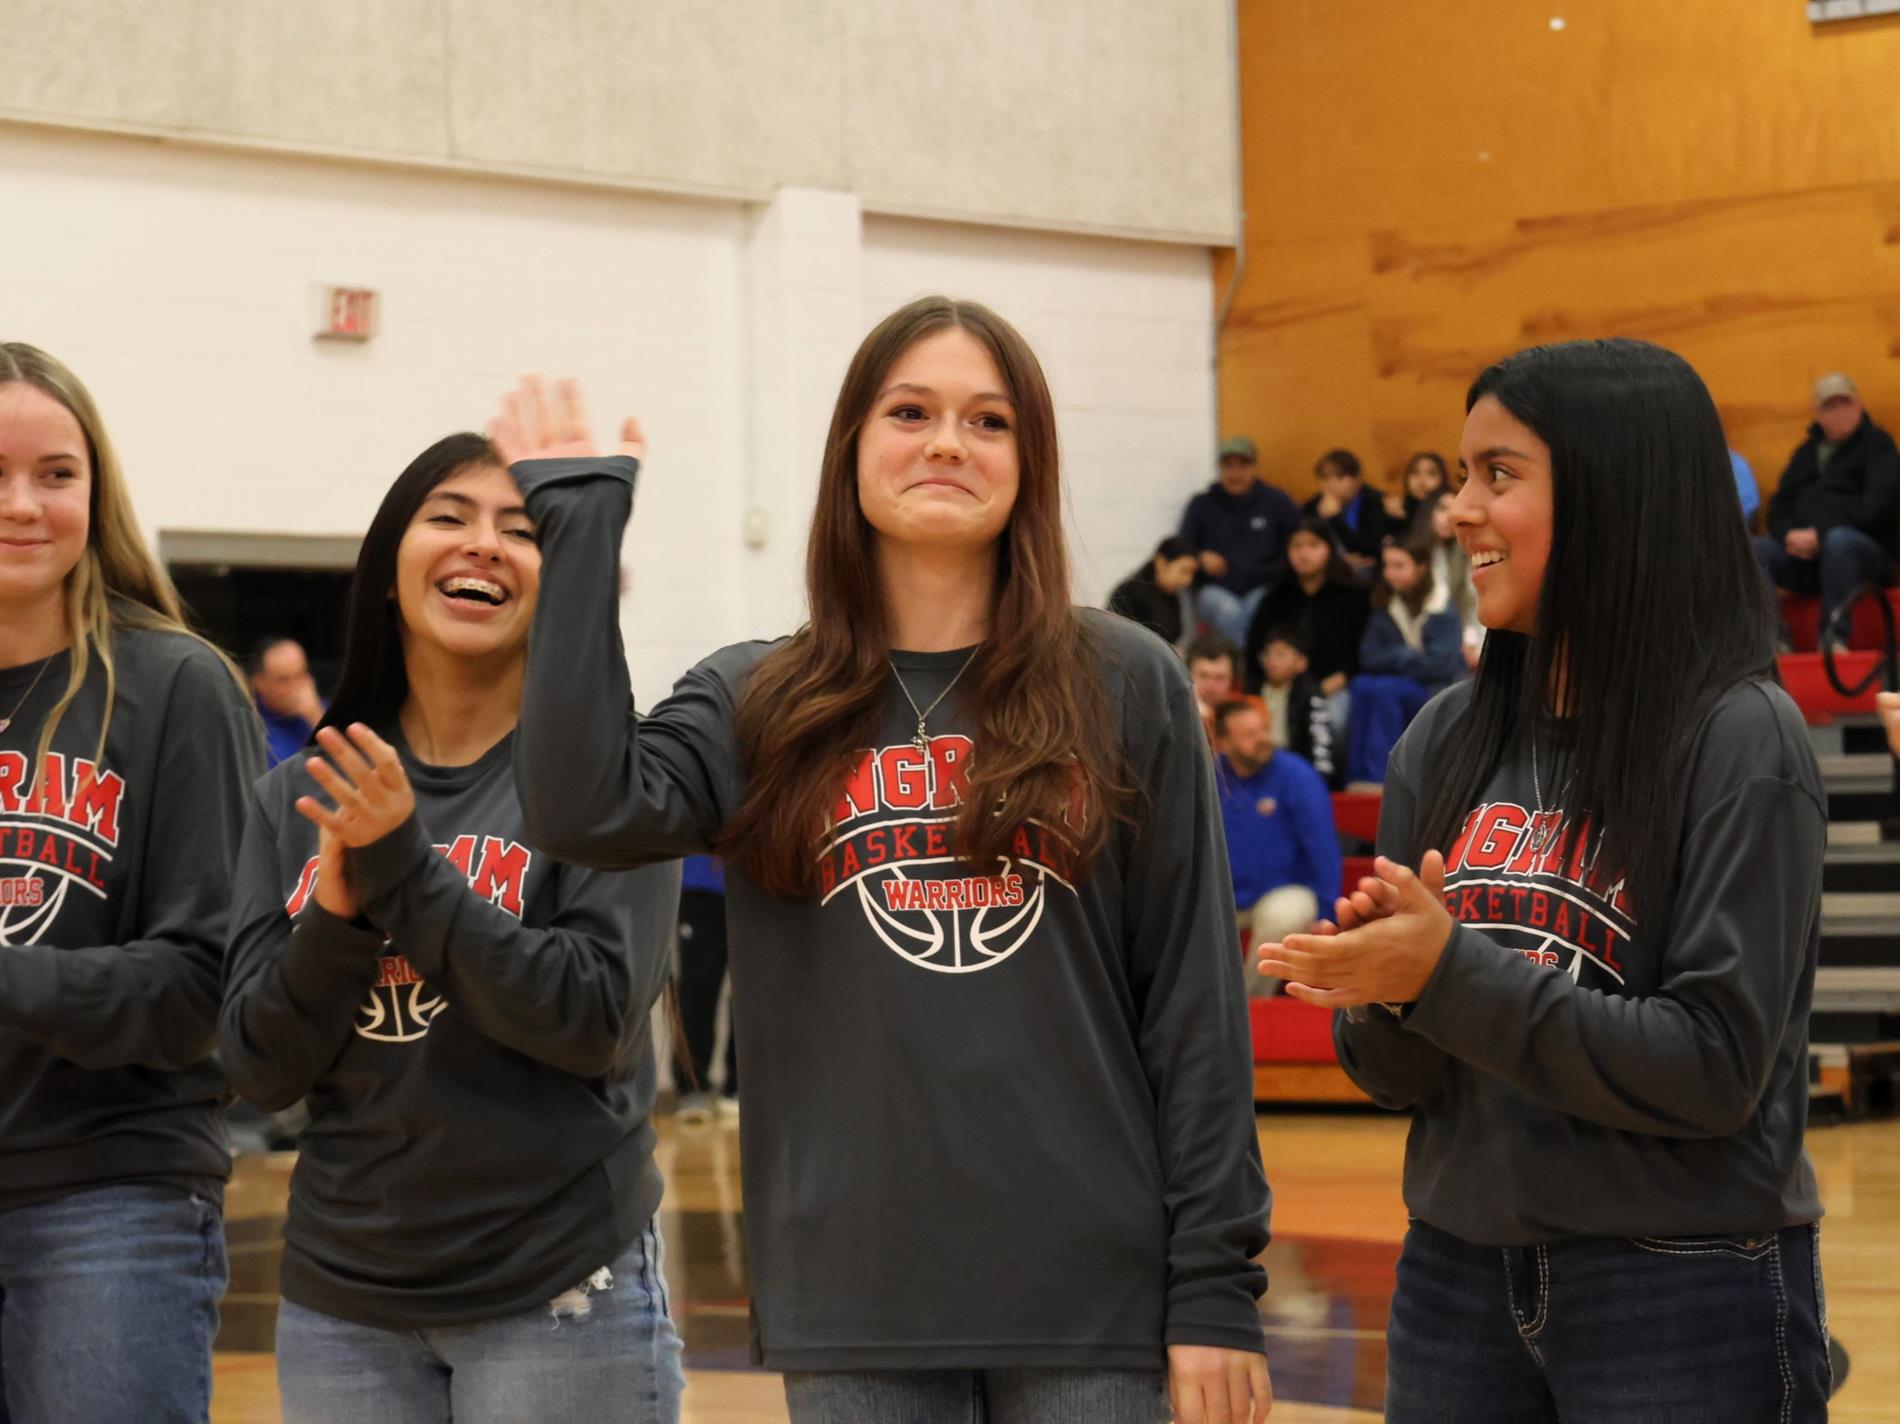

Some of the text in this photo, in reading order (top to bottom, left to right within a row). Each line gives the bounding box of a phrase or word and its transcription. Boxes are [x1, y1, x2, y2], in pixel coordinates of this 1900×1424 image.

[0, 750, 126, 849] RAM
[806, 734, 1087, 842] NGR
[818, 822, 1077, 896] BASKEAL
[881, 873, 1025, 912] WARRIORS
